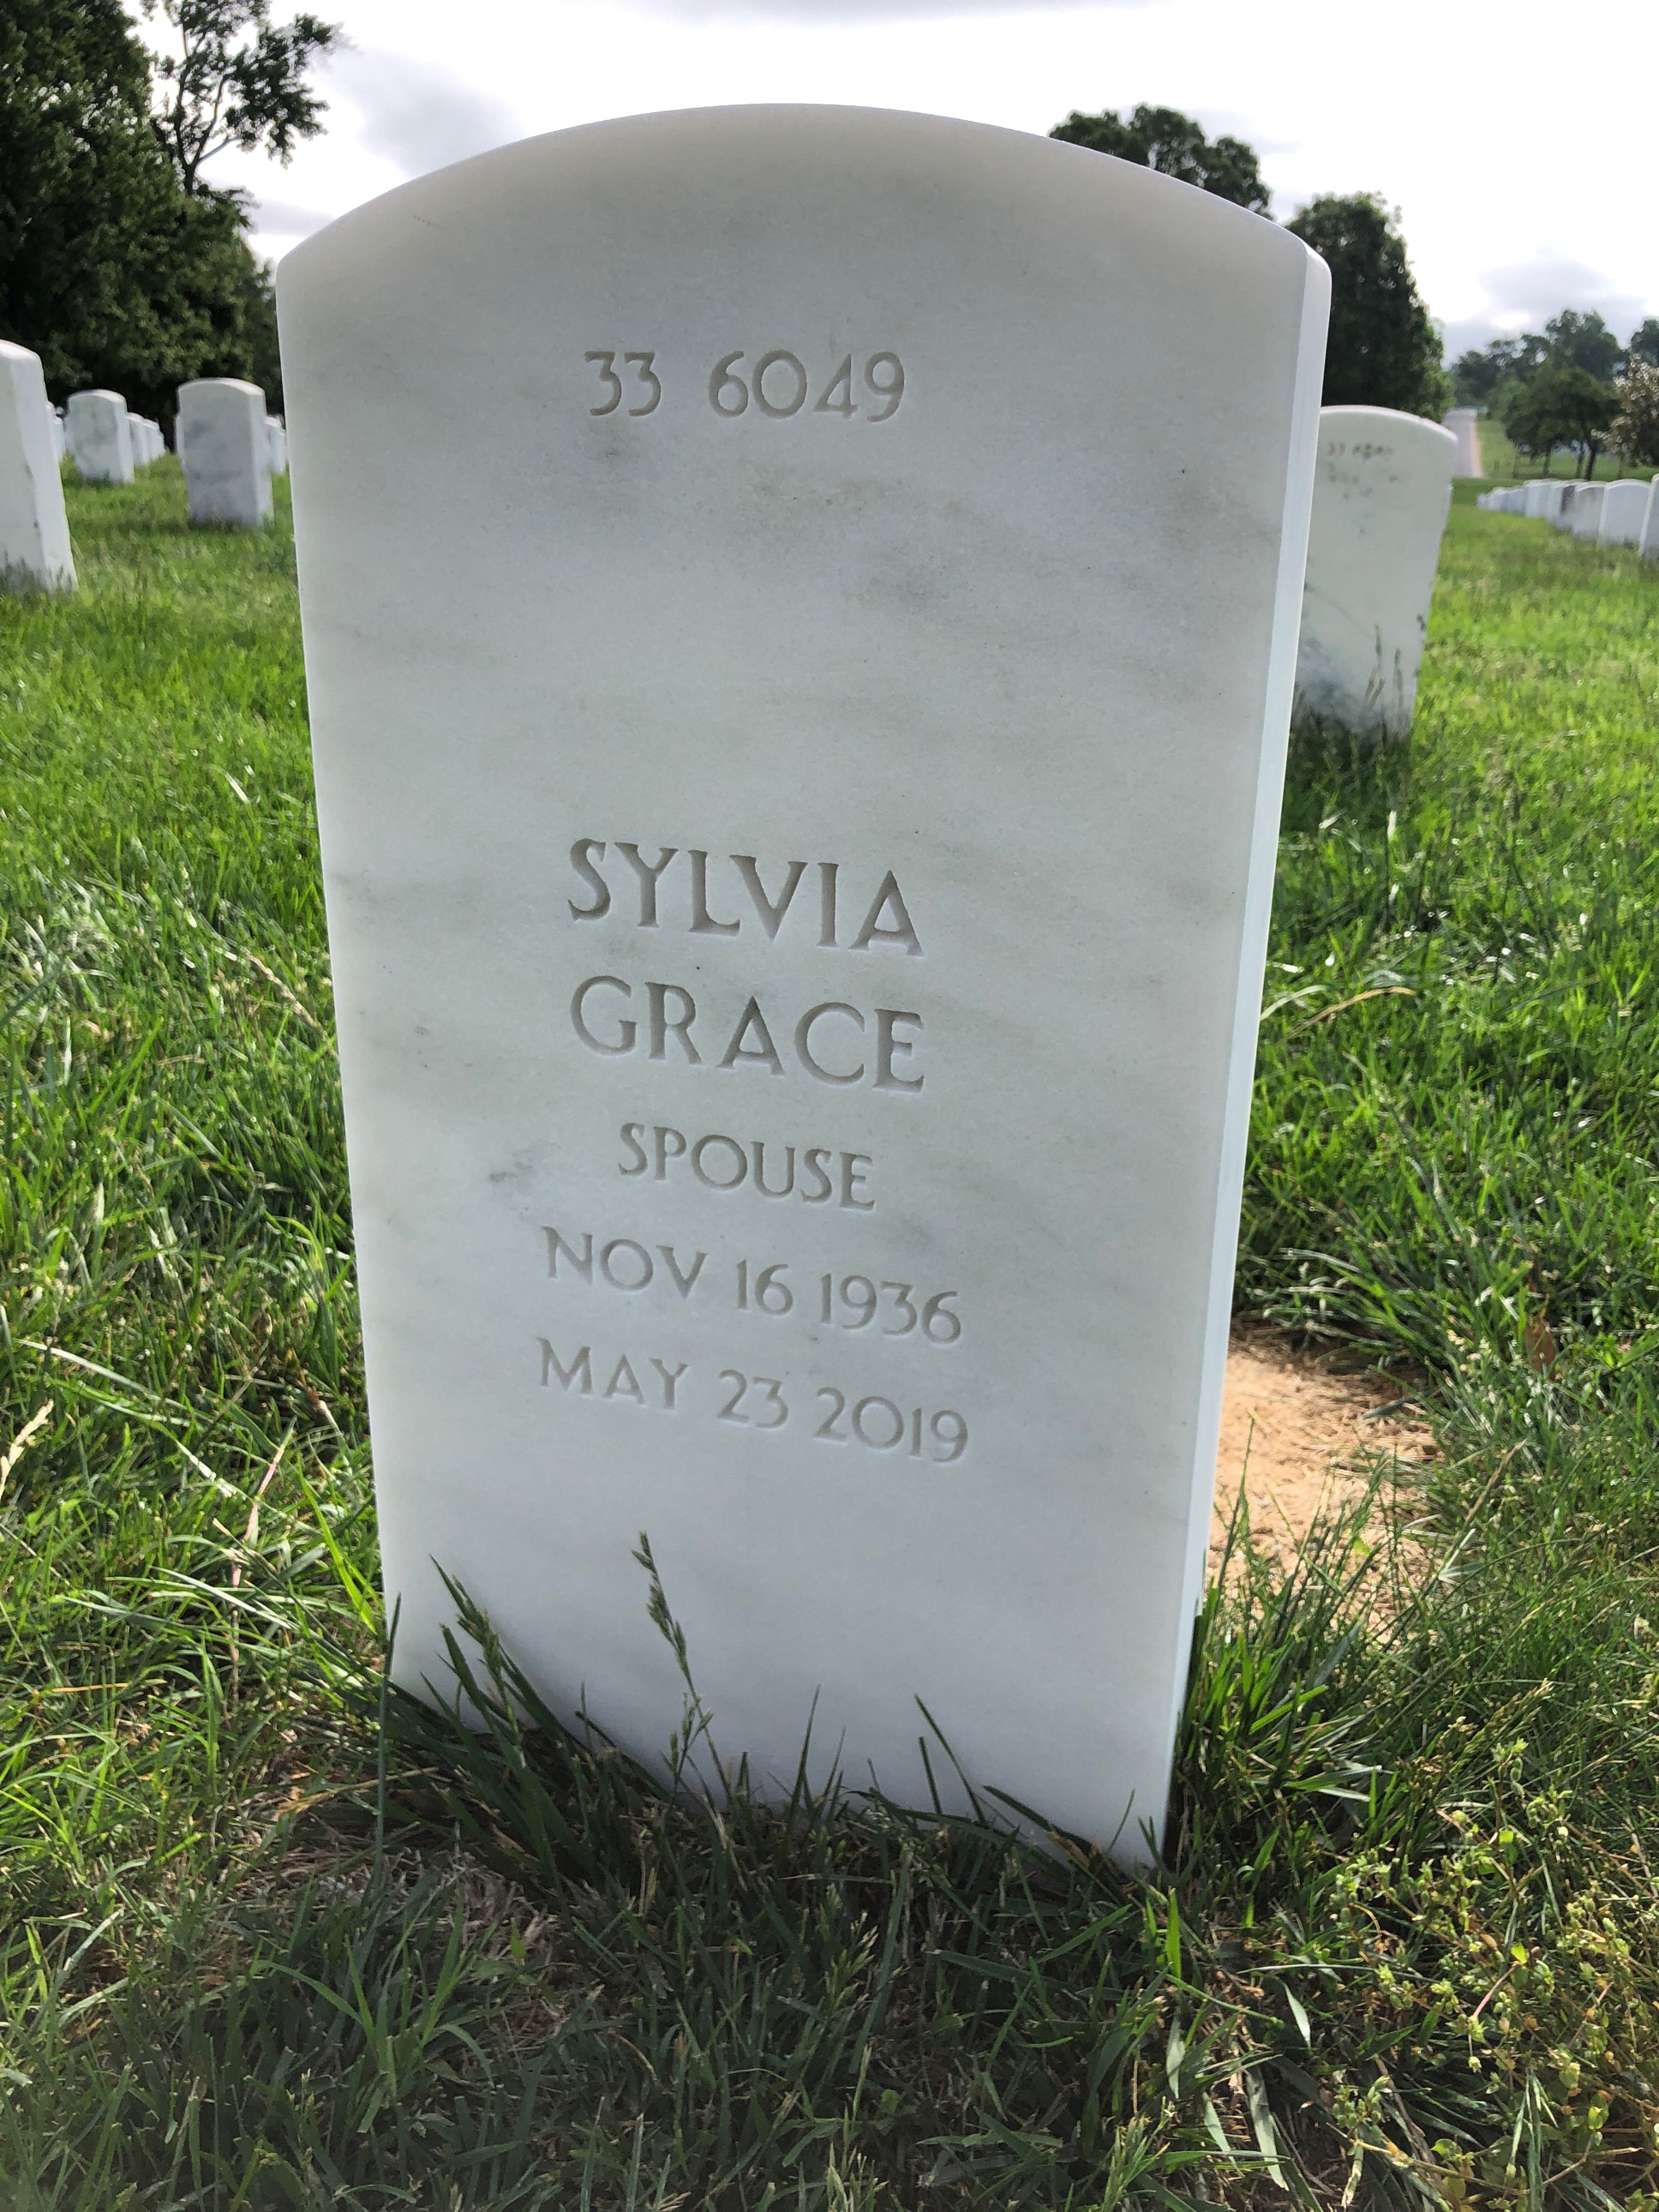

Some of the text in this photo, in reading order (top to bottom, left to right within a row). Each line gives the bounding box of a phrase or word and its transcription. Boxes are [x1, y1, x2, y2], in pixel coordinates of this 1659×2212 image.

[584, 348, 906, 423] 33 6049
[568, 837, 925, 956] SYLVIA
[571, 974, 925, 1094] GRACE
[618, 1122, 876, 1212] SPOUSE
[541, 1226, 962, 1345] NOV 16 1936
[536, 1336, 969, 1463] MAY 23 2019
